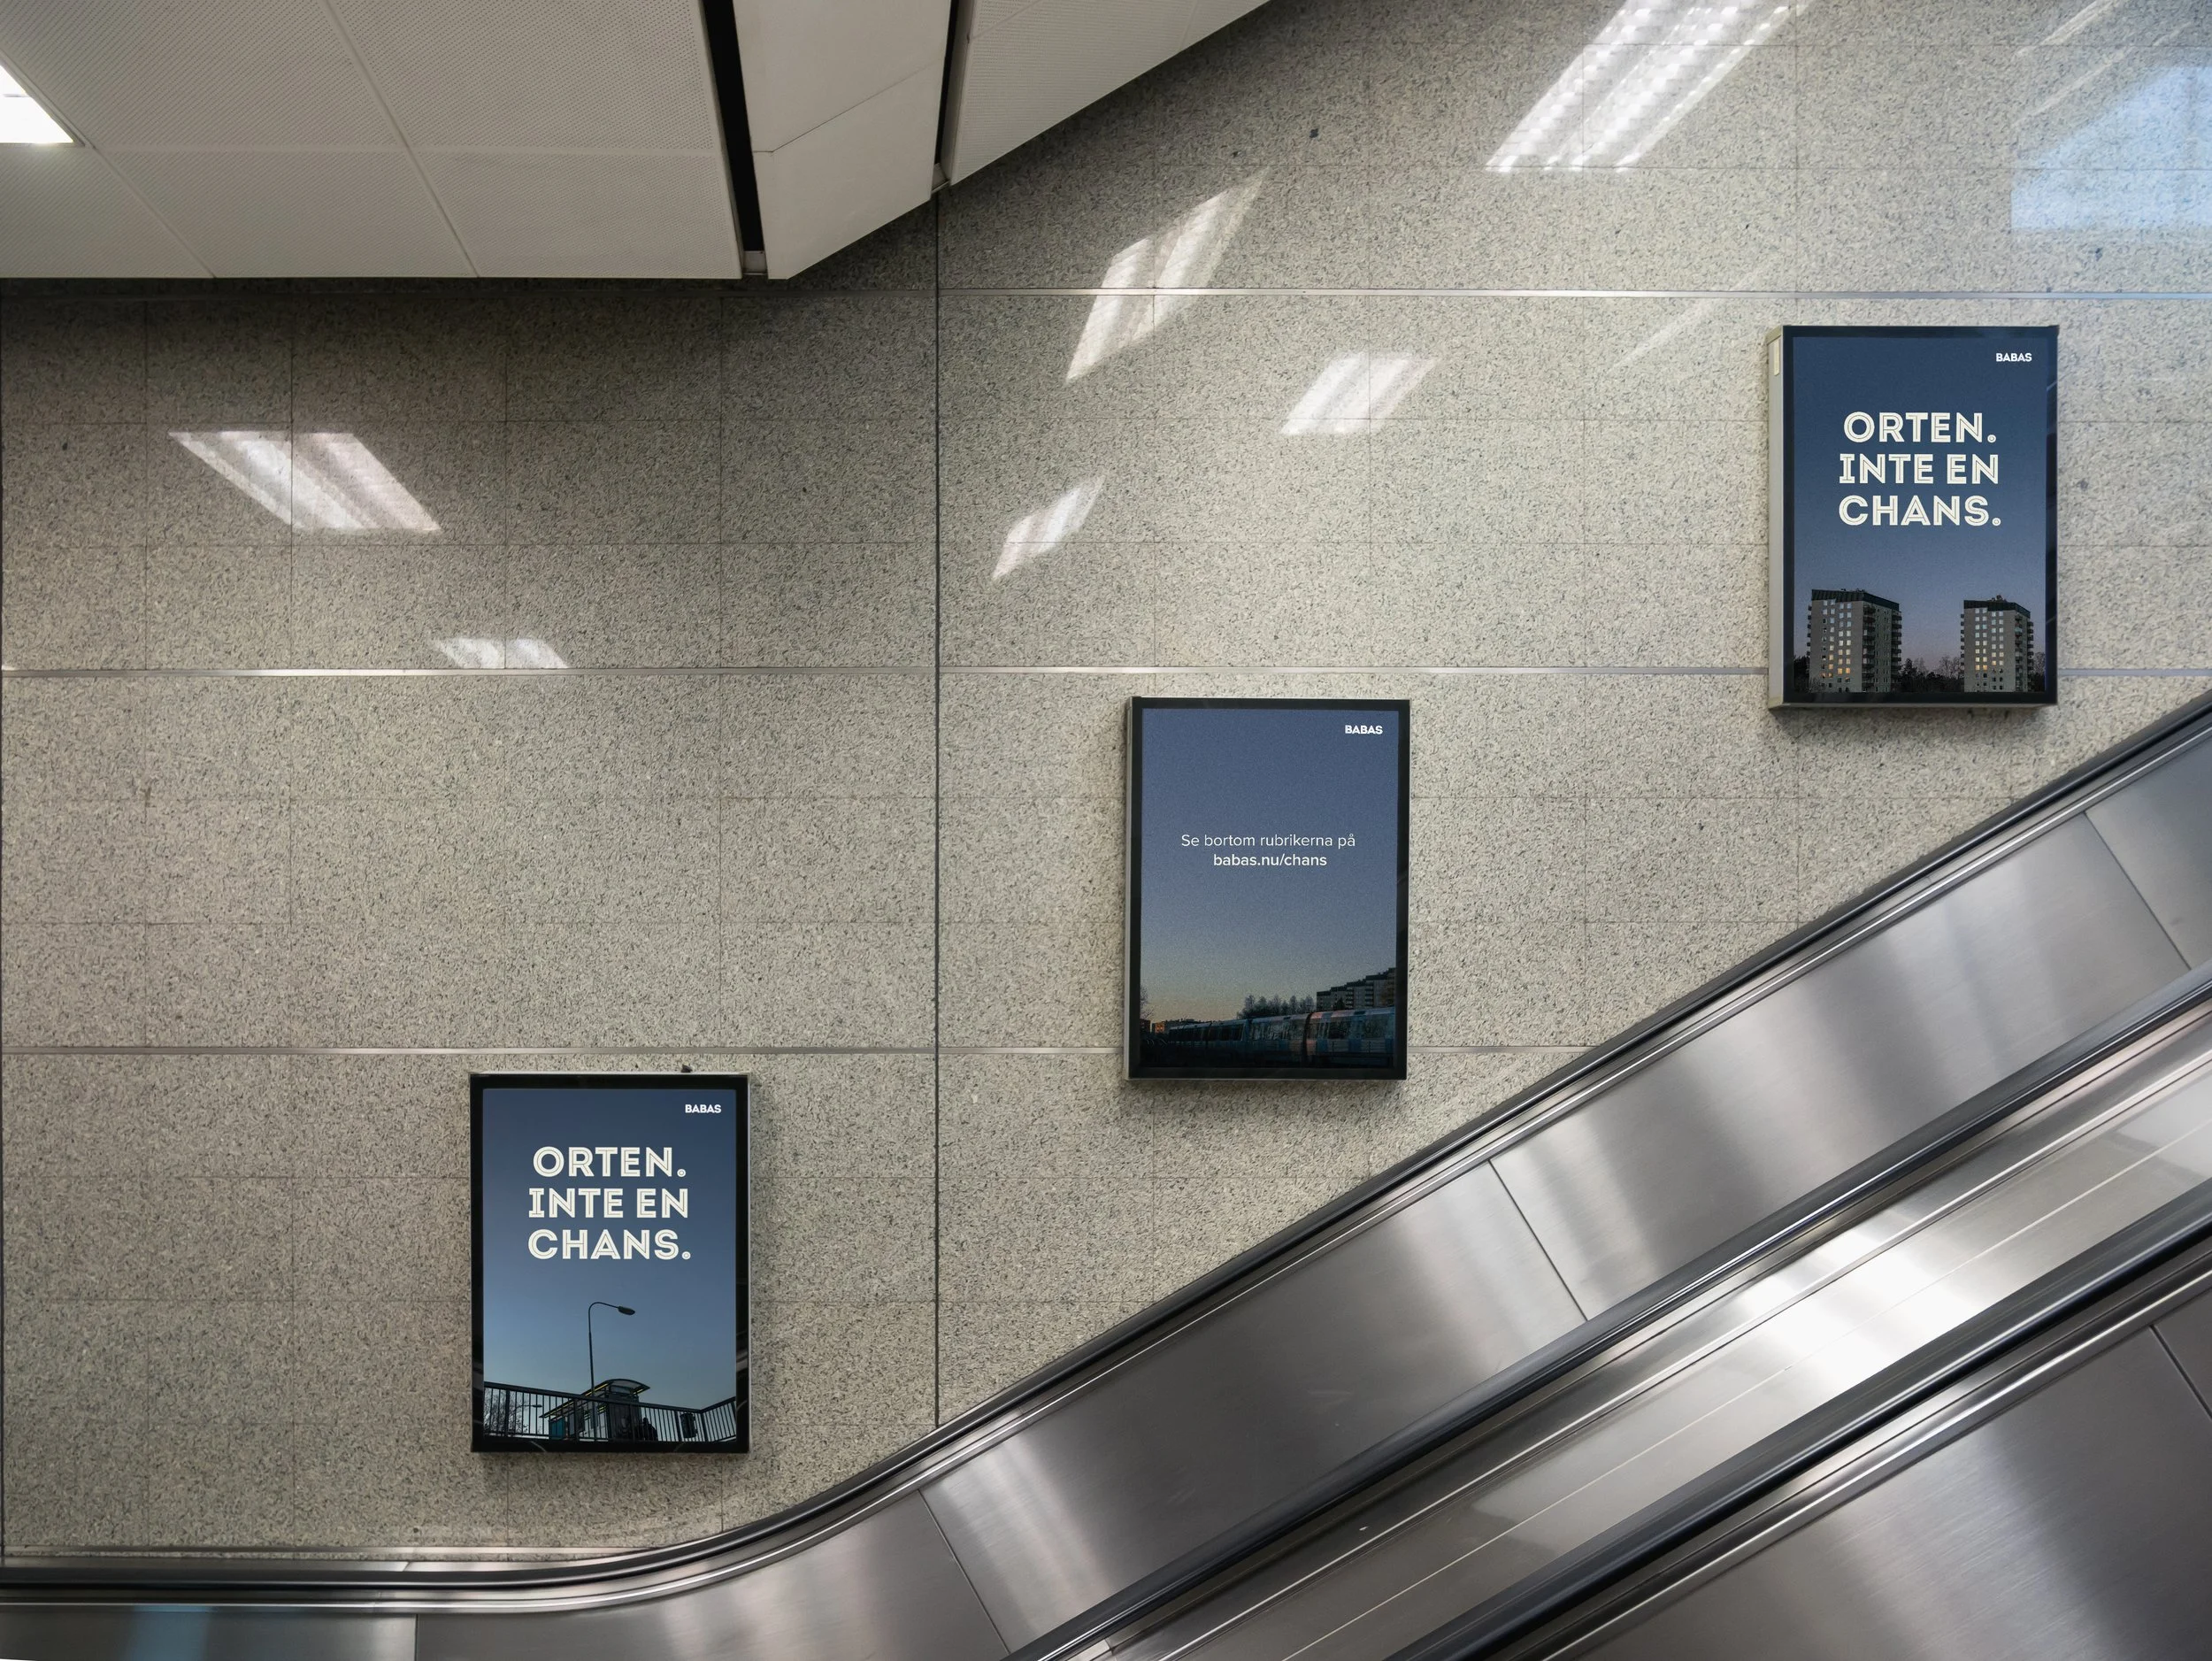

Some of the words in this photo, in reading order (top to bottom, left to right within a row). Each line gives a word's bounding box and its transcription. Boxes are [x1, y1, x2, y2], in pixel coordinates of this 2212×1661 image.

[1994, 351, 2033, 364] BABAS
[1843, 411, 1997, 443] ORTEN.
[1839, 453, 1934, 484] INTE
[1947, 453, 1999, 485] EN
[1839, 495, 2001, 527] CHANS.
[1343, 724, 1384, 735] BABAS
[1180, 833, 1201, 848] Se
[1203, 833, 1256, 848] bortom
[1259, 833, 1333, 848] rubrikerna
[1337, 833, 1356, 850] på
[1212, 853, 1328, 867] babas.nu/chans
[684, 1103, 722, 1115] BABAS
[533, 1146, 687, 1178] ORTEN.
[528, 1188, 624, 1219] INTE
[636, 1188, 688, 1219] EN
[527, 1228, 691, 1260] CHANS.
